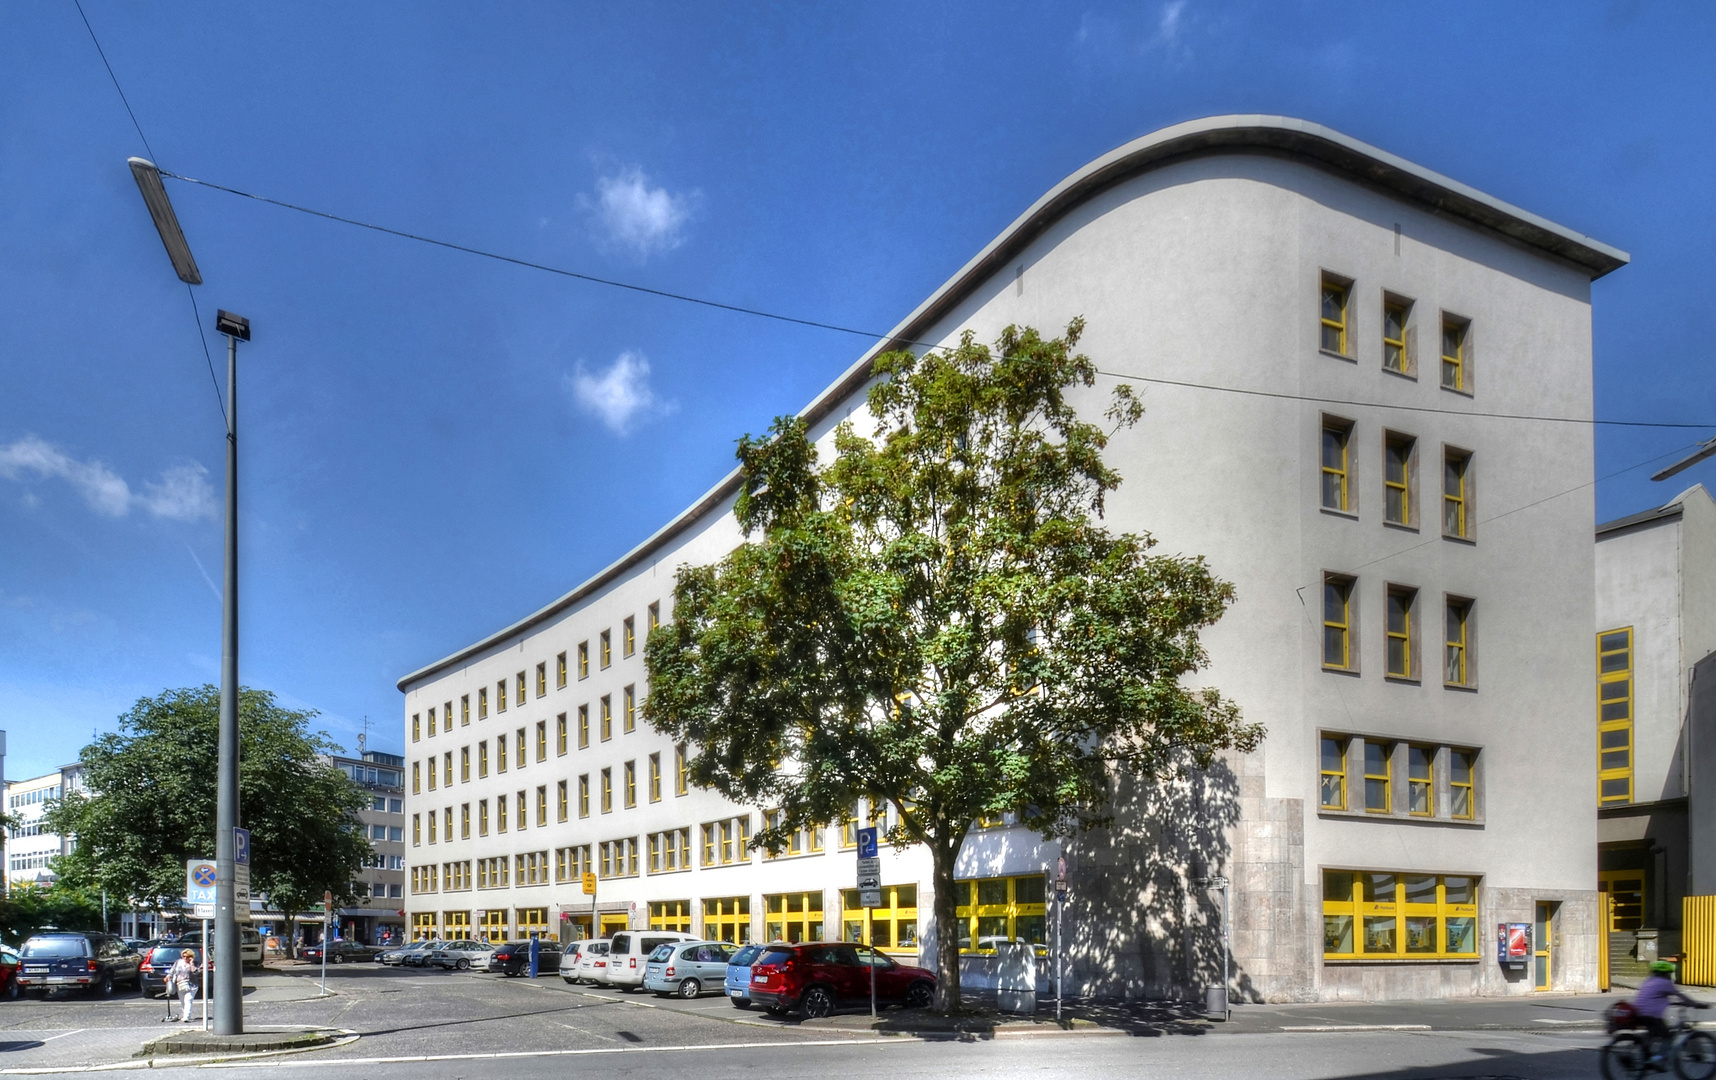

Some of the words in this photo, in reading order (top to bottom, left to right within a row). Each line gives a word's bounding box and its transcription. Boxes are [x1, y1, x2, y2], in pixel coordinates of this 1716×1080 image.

[236, 832, 245, 859] P
[860, 831, 871, 855] P
[192, 890, 214, 900] TAX
